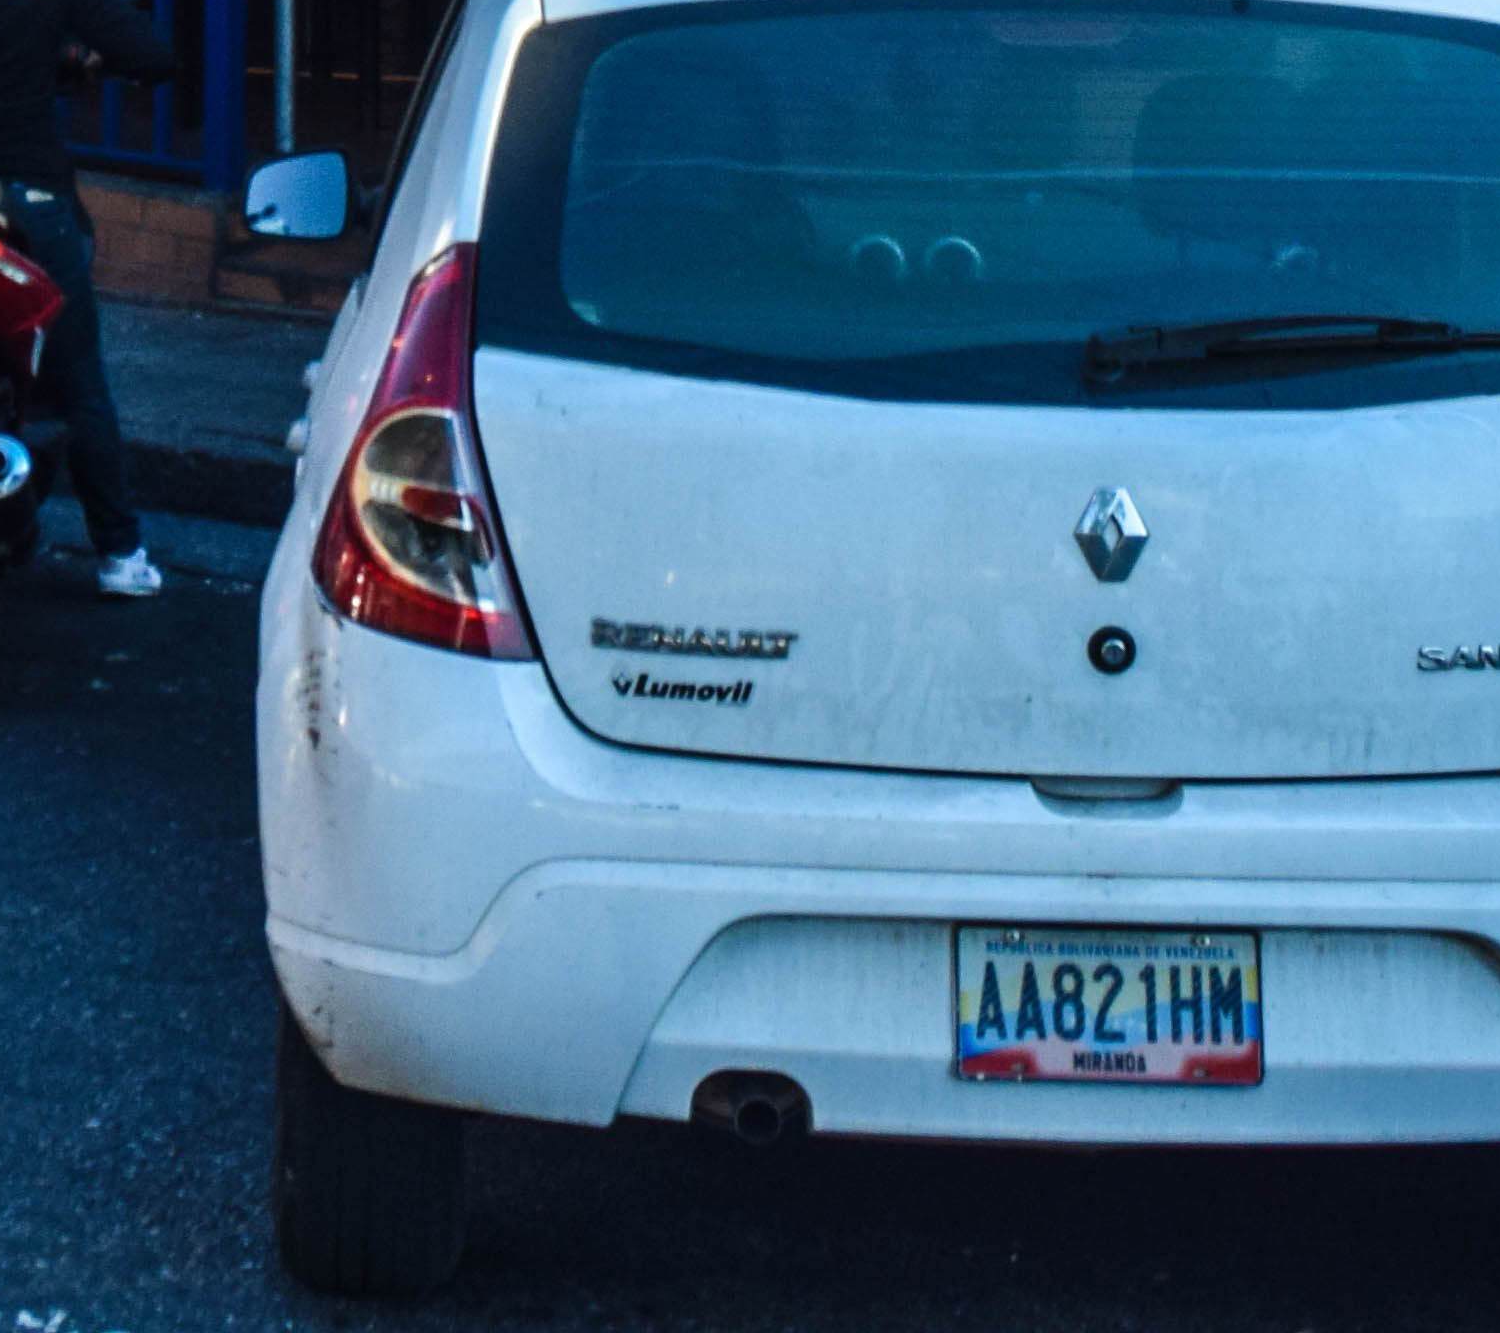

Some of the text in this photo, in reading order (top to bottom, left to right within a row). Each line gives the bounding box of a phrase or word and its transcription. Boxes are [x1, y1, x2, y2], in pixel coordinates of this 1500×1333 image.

[590, 615, 799, 661] RENAULT
[975, 960, 1245, 1045] AA821HM
[1072, 1051, 1148, 1074] MIRANDA
